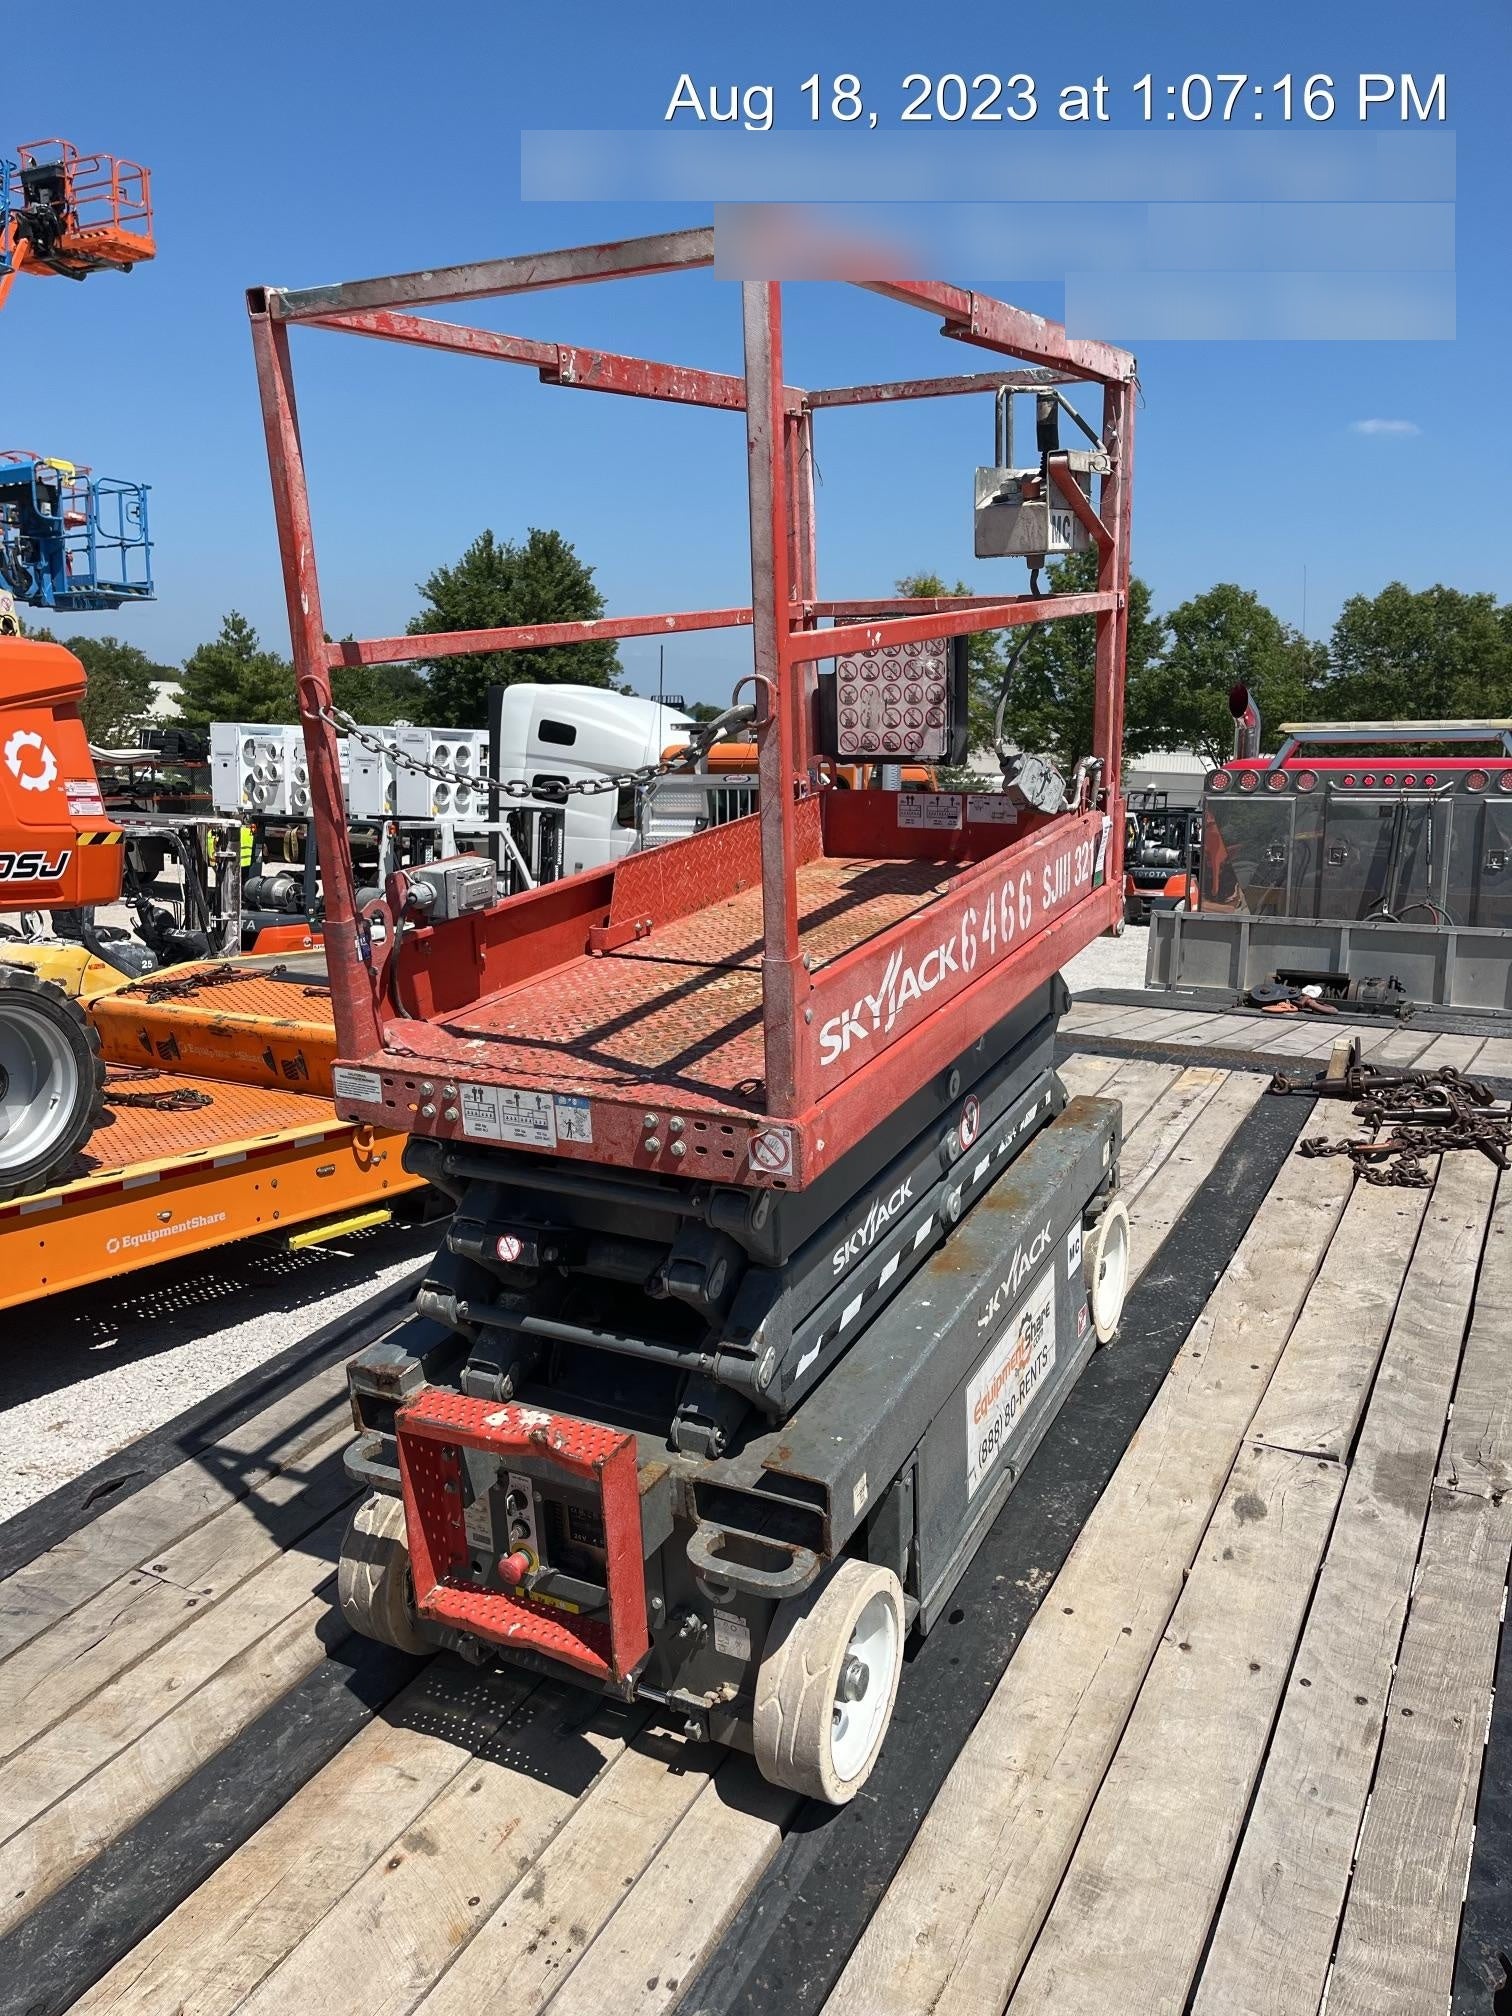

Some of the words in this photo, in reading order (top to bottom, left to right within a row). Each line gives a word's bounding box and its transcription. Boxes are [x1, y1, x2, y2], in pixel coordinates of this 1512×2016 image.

[1051, 515, 1071, 544] MC
[1134, 870, 1167, 878] TOYOTA
[141, 960, 153, 969] 25
[819, 947, 960, 1066] SKYJACK
[961, 869, 1032, 973] 6466
[121, 1211, 227, 1248] EquipmentShare
[833, 1176, 914, 1275] SKYJACK
[1069, 1238, 1081, 1264] MC
[978, 1414, 1004, 1470] (888)
[1004, 1343, 1049, 1428] 80-RENTS
